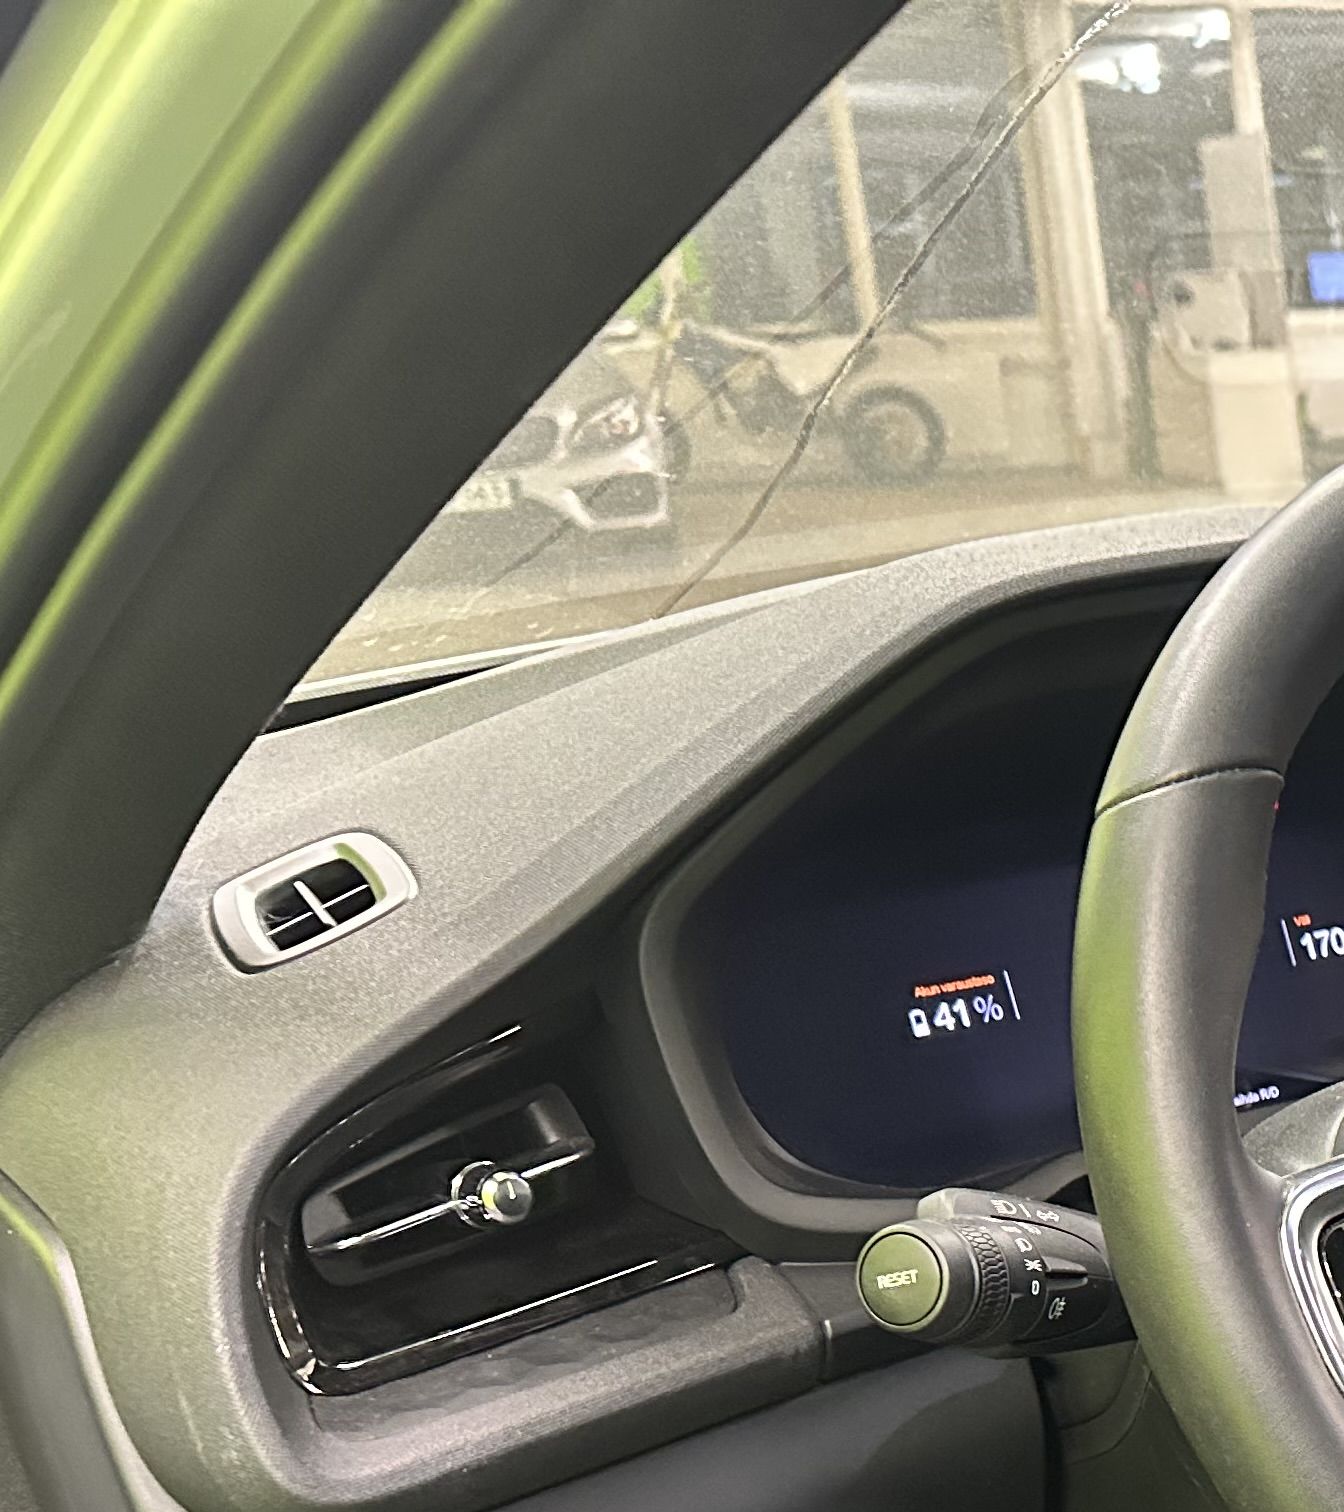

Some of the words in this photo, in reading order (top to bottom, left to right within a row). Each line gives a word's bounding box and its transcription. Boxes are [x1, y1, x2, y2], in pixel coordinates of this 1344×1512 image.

[932, 998, 971, 1031] 41
[972, 994, 1004, 1023] %
[877, 1269, 919, 1289] RESET
